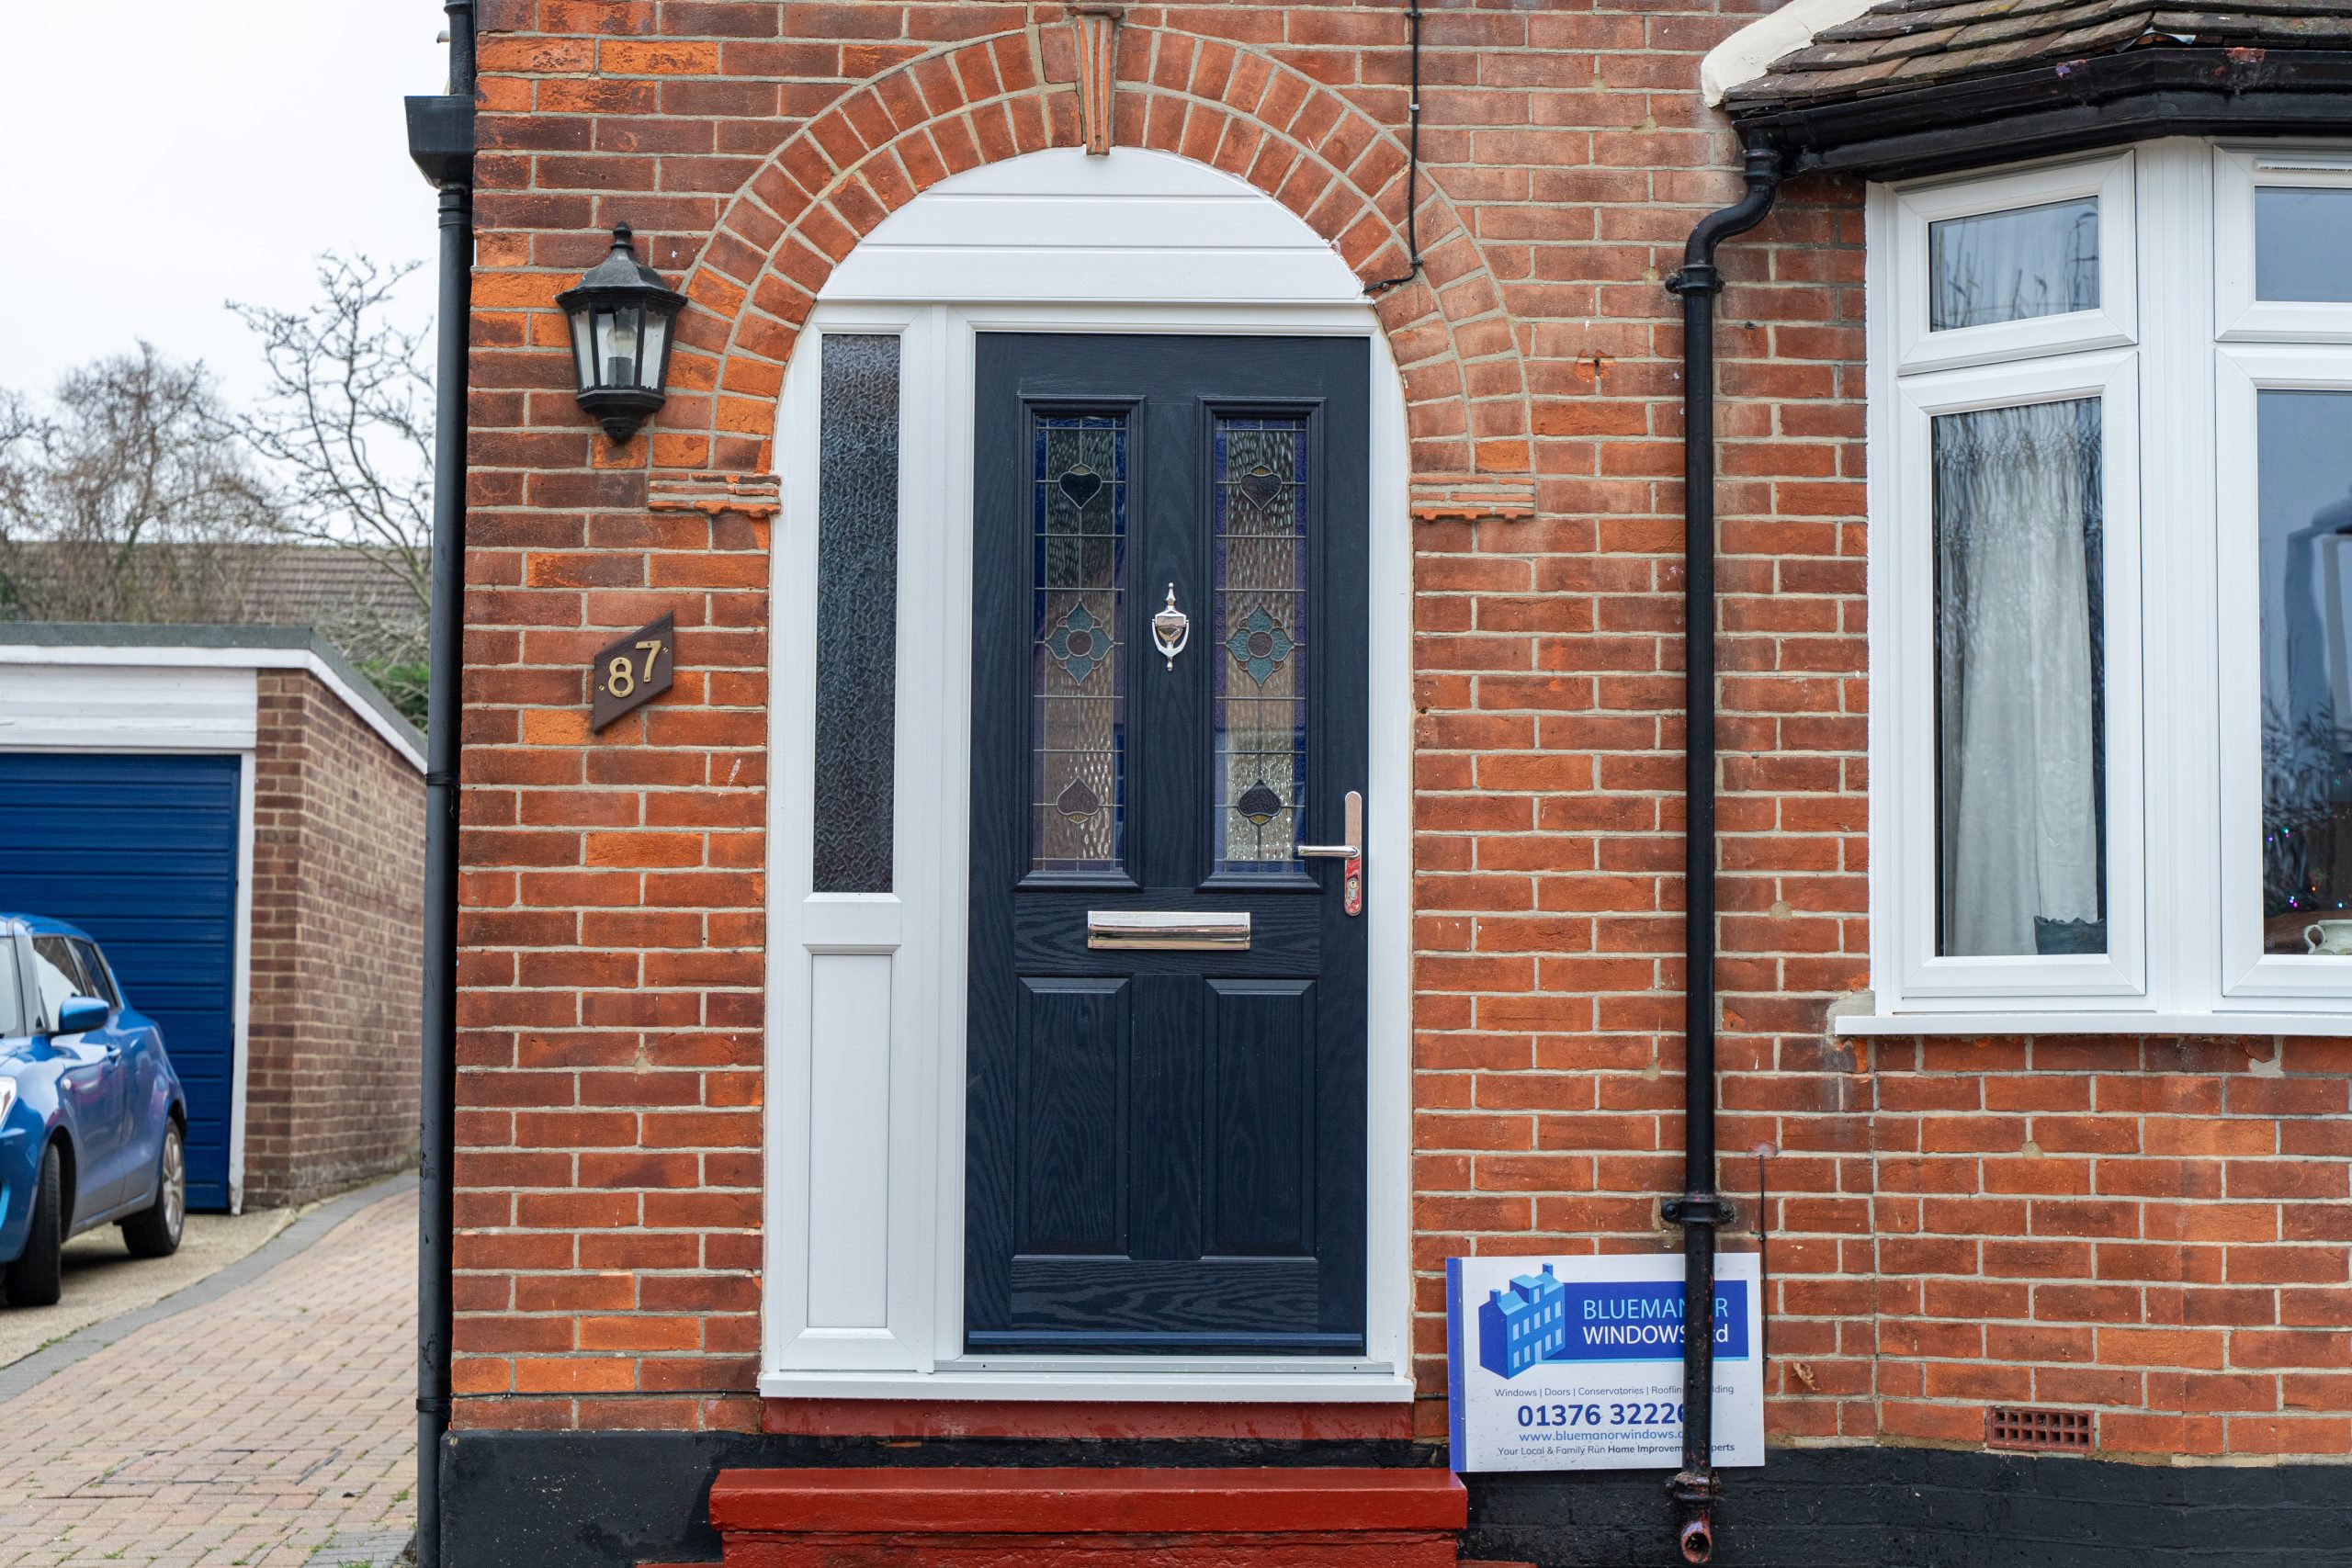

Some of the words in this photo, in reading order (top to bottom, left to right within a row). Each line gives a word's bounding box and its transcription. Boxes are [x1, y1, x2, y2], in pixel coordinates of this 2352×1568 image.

[608, 640, 662, 698] 87
[1583, 1298, 1728, 1320] BLUEMAR
[1494, 1388, 1537, 1397] Windows
[1544, 1388, 1571, 1396] Doors
[1577, 1386, 1645, 1395] Conservatories
[1651, 1385, 1683, 1394] Rooflin
[1517, 1404, 1601, 1427] 01376
[1610, 1402, 1684, 1426] 3222
[1521, 1447, 1544, 1455] Local
[1546, 1446, 1555, 1454] &
[1555, 1445, 1586, 1455] Family
[1588, 1445, 1606, 1454] Run
[1608, 1445, 1635, 1453] Home
[1637, 1444, 1683, 1454] Improvem
